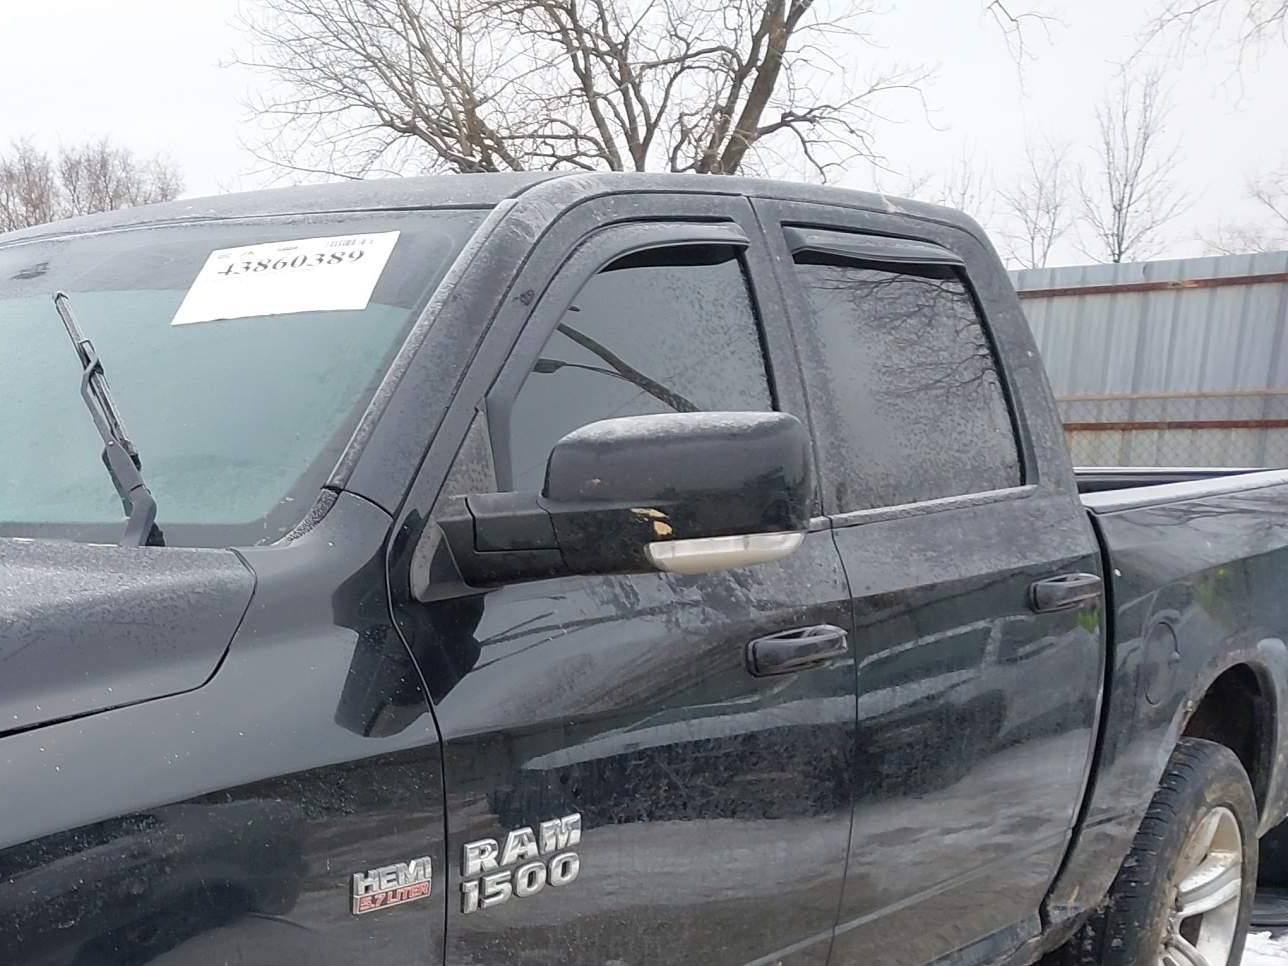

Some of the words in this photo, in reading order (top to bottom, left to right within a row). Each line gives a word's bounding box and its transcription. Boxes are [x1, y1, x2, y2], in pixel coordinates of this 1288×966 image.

[217, 249, 365, 277] 43860389
[463, 813, 582, 876] RAM
[353, 856, 432, 896] HEMI
[463, 852, 581, 914] 1500
[358, 892, 387, 912] 5.7
[386, 881, 430, 904] LITER
